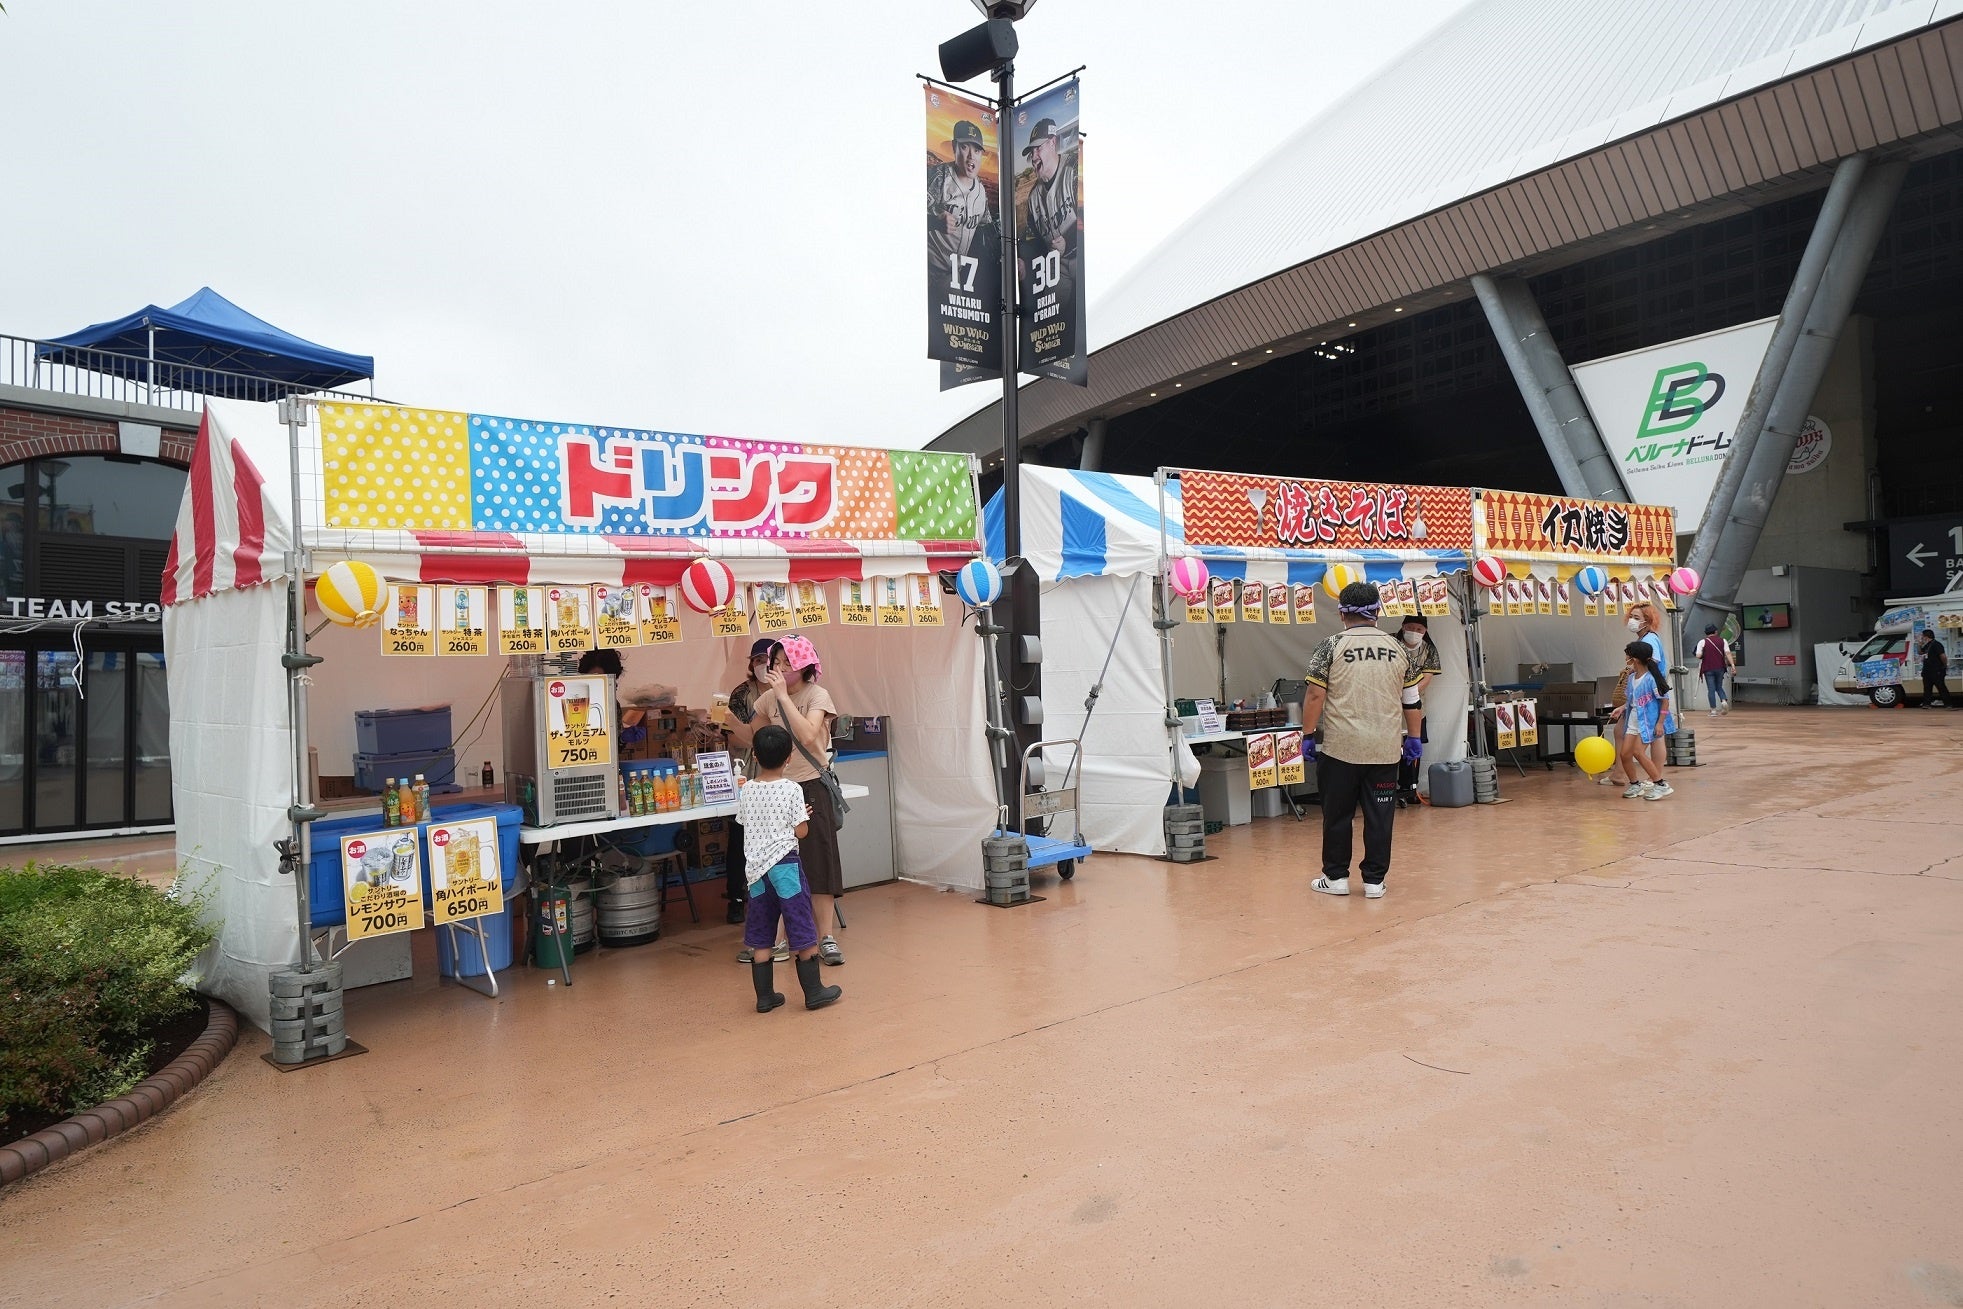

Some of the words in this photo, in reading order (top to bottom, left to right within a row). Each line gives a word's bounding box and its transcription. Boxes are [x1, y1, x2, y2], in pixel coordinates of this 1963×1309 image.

[949, 252, 979, 293] 17
[1031, 249, 1061, 295] 30
[948, 293, 982, 310] WATARU
[1036, 292, 1056, 310] BRIAN
[940, 303, 990, 324] MATSUMOTO
[1033, 303, 1060, 323] O'GRADY
[563, 437, 834, 527] ドリンク
[1275, 481, 1408, 544] 焼きそば
[1541, 502, 1629, 551] イカ焼き
[6, 596, 93, 619] TEAM
[795, 605, 826, 615] 角ハイボール
[642, 616, 679, 625] ザ・プレミアム
[759, 611, 791, 620] レモンサワー
[802, 614, 823, 623] 650円
[847, 613, 868, 622] 260円
[884, 614, 903, 623] 260円
[918, 614, 938, 623] 260円
[719, 623, 742, 633] 750円
[764, 619, 788, 629] 700円
[390, 628, 428, 636] なっちゃん
[463, 628, 483, 636] 特茶
[522, 628, 543, 638] 特茶
[550, 629, 591, 637] 角ハイボール
[598, 626, 637, 635] レモンサワー
[650, 630, 674, 641] 750円
[558, 638, 585, 648] 650円
[605, 634, 632, 645] 700円
[392, 641, 424, 651] 260円
[448, 641, 478, 651] 260円
[509, 640, 537, 650] 260円
[1343, 646, 1397, 663] STAFF
[550, 728, 607, 740] ザ・プレミアム
[568, 738, 590, 746] モルツ
[560, 748, 598, 762] 750円
[433, 833, 450, 843] お酒
[348, 845, 366, 855] お酒
[452, 877, 480, 886] サントリー
[367, 884, 399, 895] サントリー
[435, 881, 498, 902] 角ハイボール
[360, 890, 407, 902] こだわり酒場の
[350, 897, 419, 917] レモンサワー
[447, 898, 489, 917] 650円
[361, 912, 408, 933] 700円
